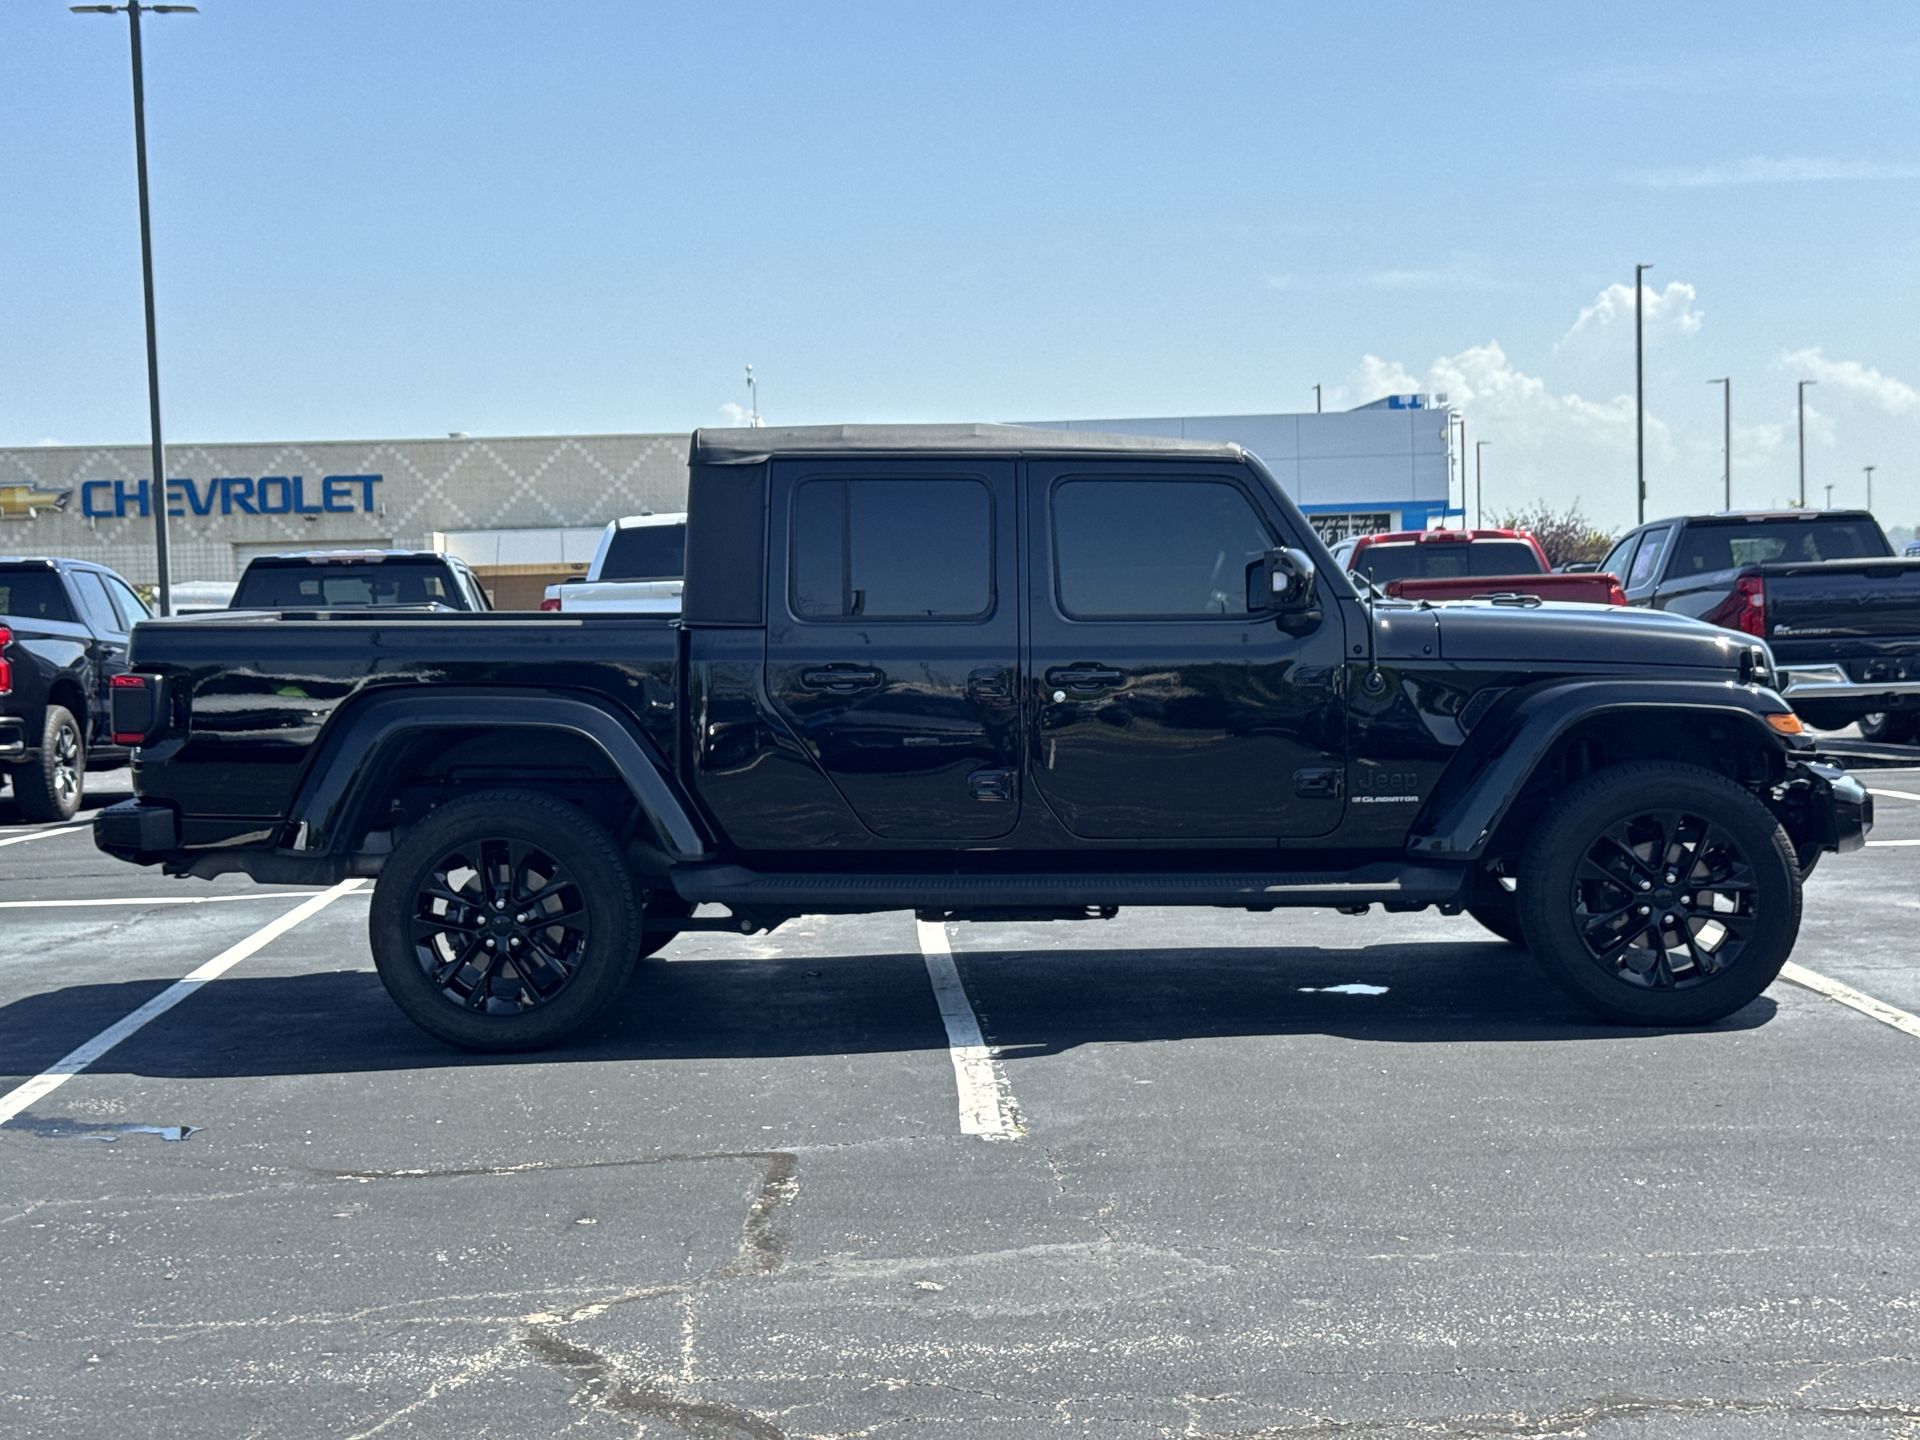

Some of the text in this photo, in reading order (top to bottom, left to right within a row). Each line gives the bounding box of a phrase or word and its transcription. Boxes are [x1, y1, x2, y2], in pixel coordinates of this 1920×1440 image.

[81, 475, 384, 517] CHEVROLET
[1319, 529, 1333, 543] OF
[1358, 769, 1418, 792] Jeep
